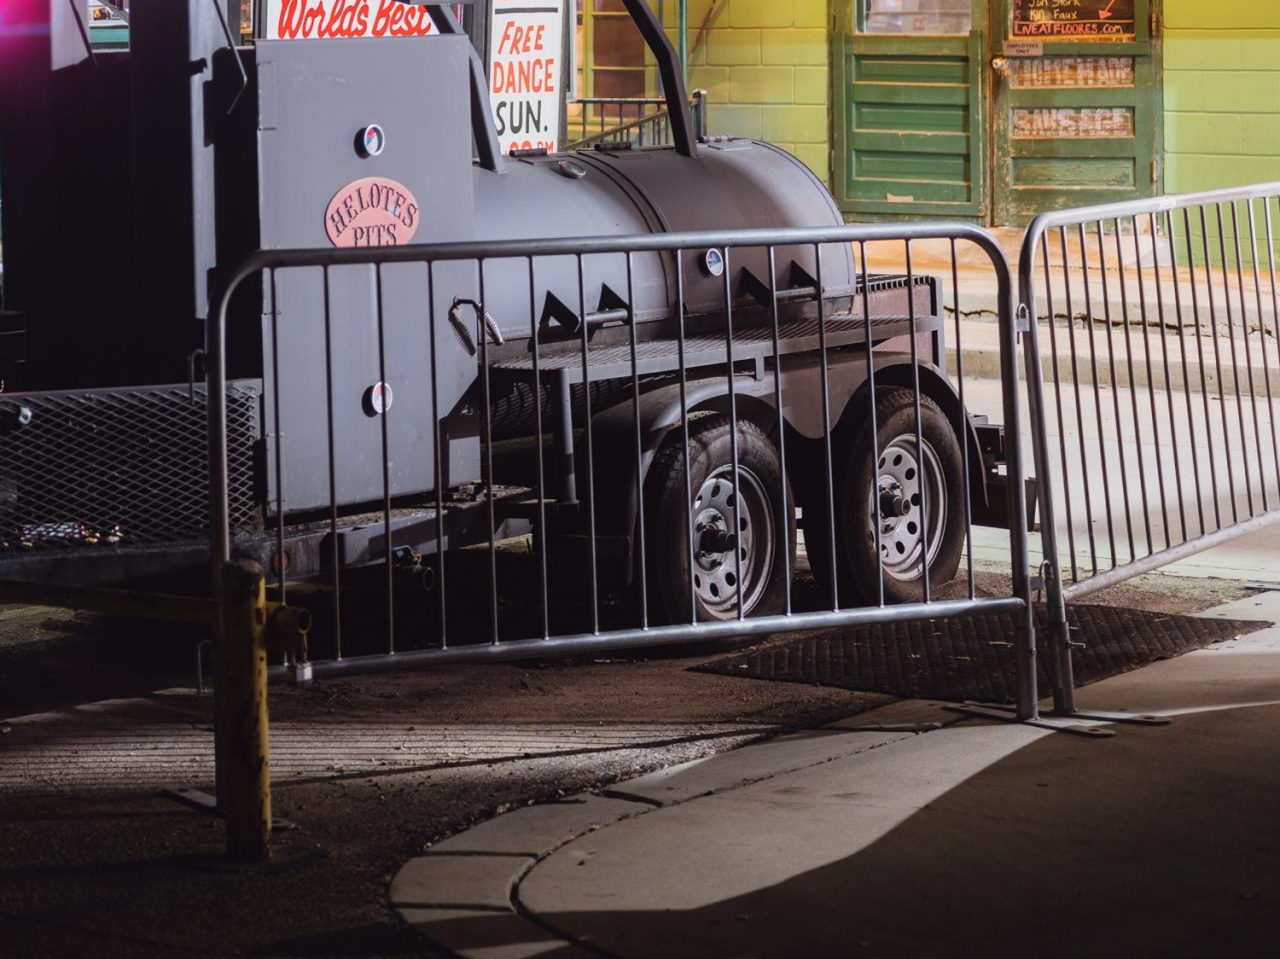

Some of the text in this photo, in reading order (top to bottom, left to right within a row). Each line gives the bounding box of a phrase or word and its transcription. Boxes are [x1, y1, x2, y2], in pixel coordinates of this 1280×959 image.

[498, 20, 545, 55] FREE
[493, 59, 554, 93] DANCE
[496, 100, 548, 136] SUN.
[329, 183, 417, 238] HELOTES
[352, 223, 397, 247] PITS
